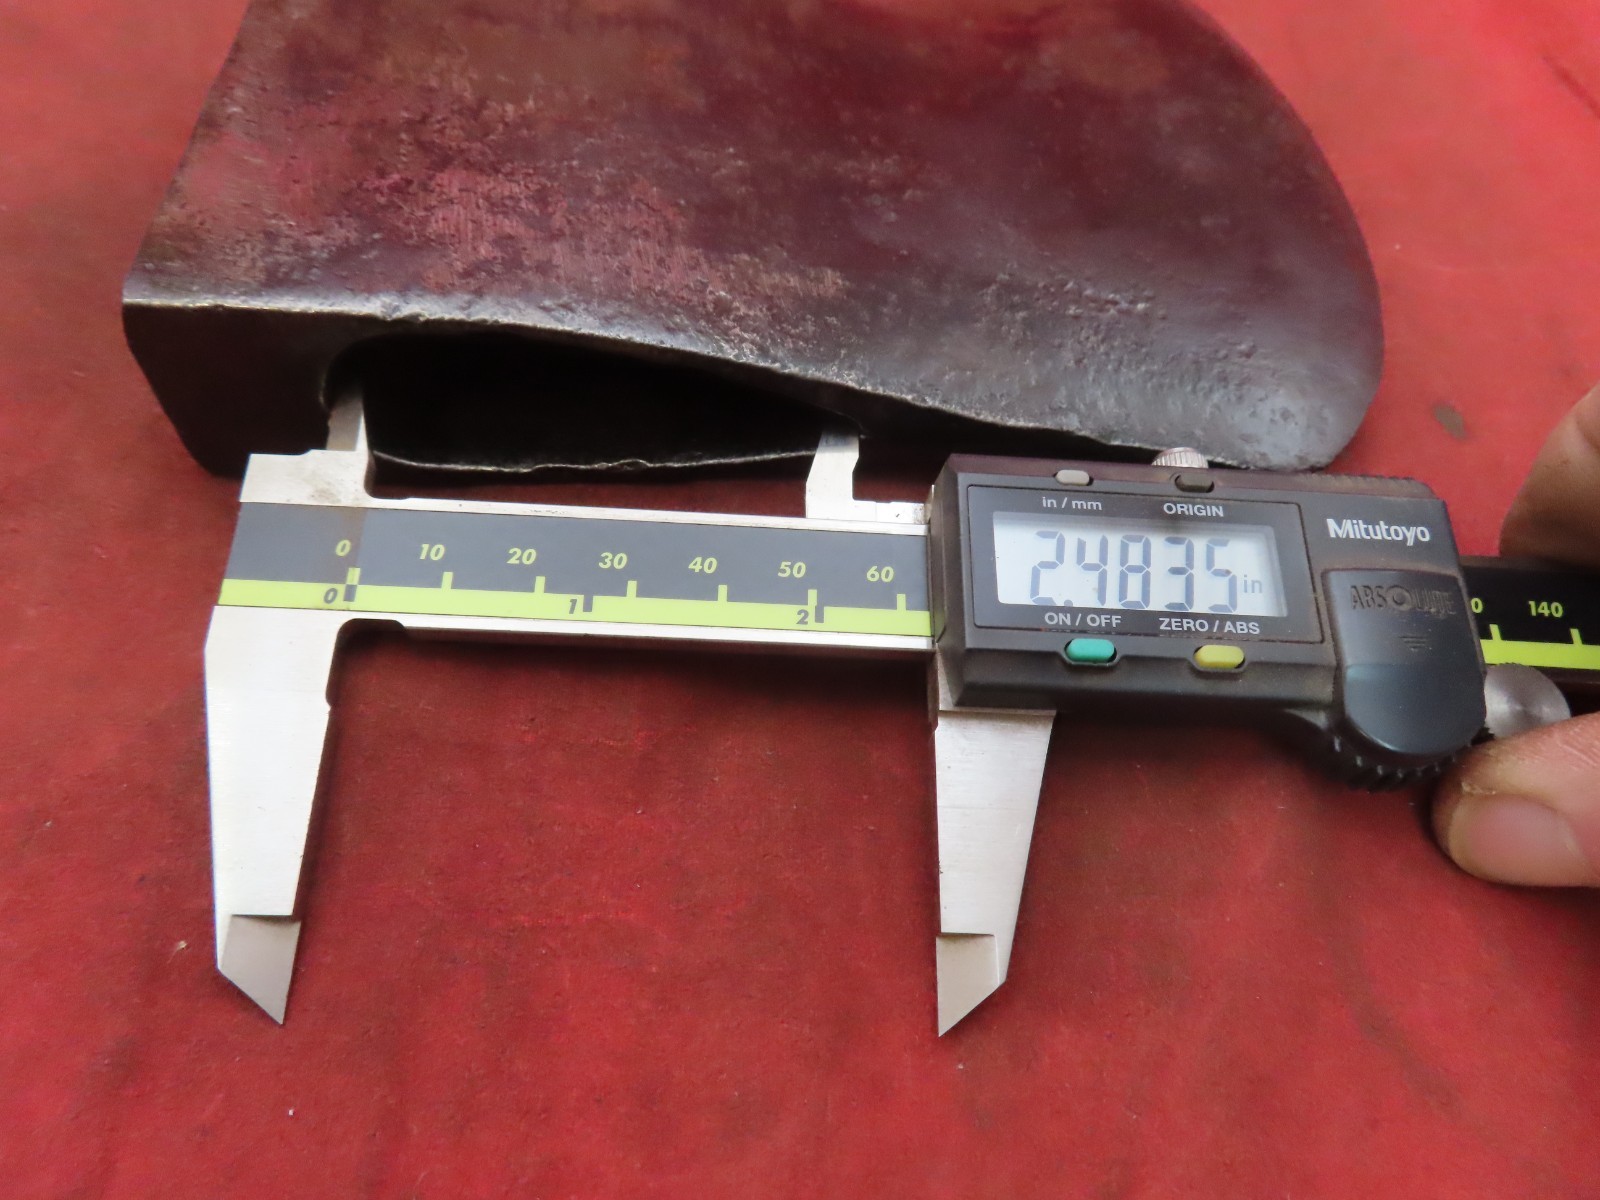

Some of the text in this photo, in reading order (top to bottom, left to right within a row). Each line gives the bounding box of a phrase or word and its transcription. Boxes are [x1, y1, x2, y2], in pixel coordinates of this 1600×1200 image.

[1042, 497, 1056, 508] in
[1072, 500, 1102, 511] mm
[1163, 502, 1224, 518] ORIGIN
[1326, 518, 1430, 546] Mitutoyo
[335, 540, 895, 583] 0 10 20 30 40 50 60
[1243, 575, 1263, 594] in
[323, 588, 809, 625] 0 1 2
[1528, 600, 1563, 618] 140
[1044, 612, 1073, 625] ON
[1086, 615, 1122, 628] OFF
[1159, 617, 1209, 632] ZERO
[1224, 621, 1261, 635] ABS
